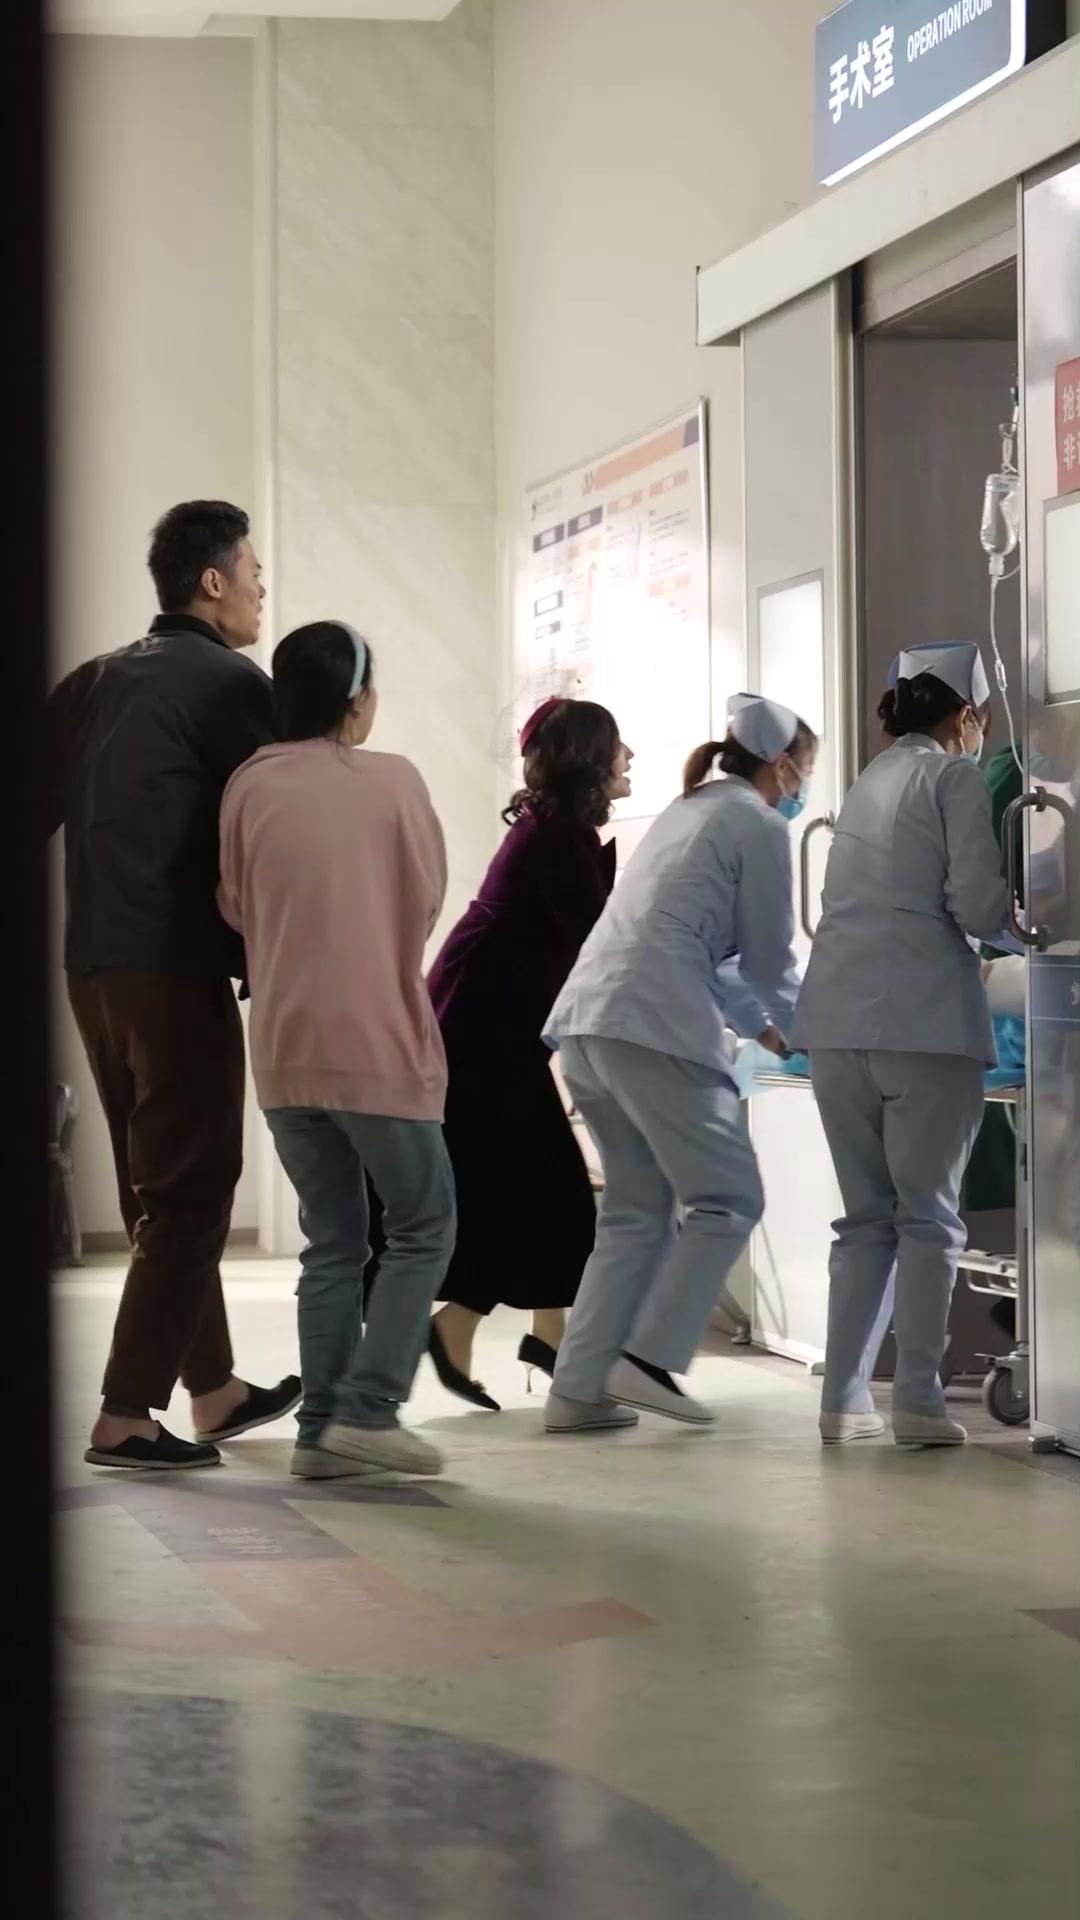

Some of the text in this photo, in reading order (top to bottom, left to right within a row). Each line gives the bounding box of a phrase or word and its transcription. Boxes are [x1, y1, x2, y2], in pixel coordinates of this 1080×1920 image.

[907, 1, 962, 63] OPERATION
[828, 24, 895, 125] 手术室
